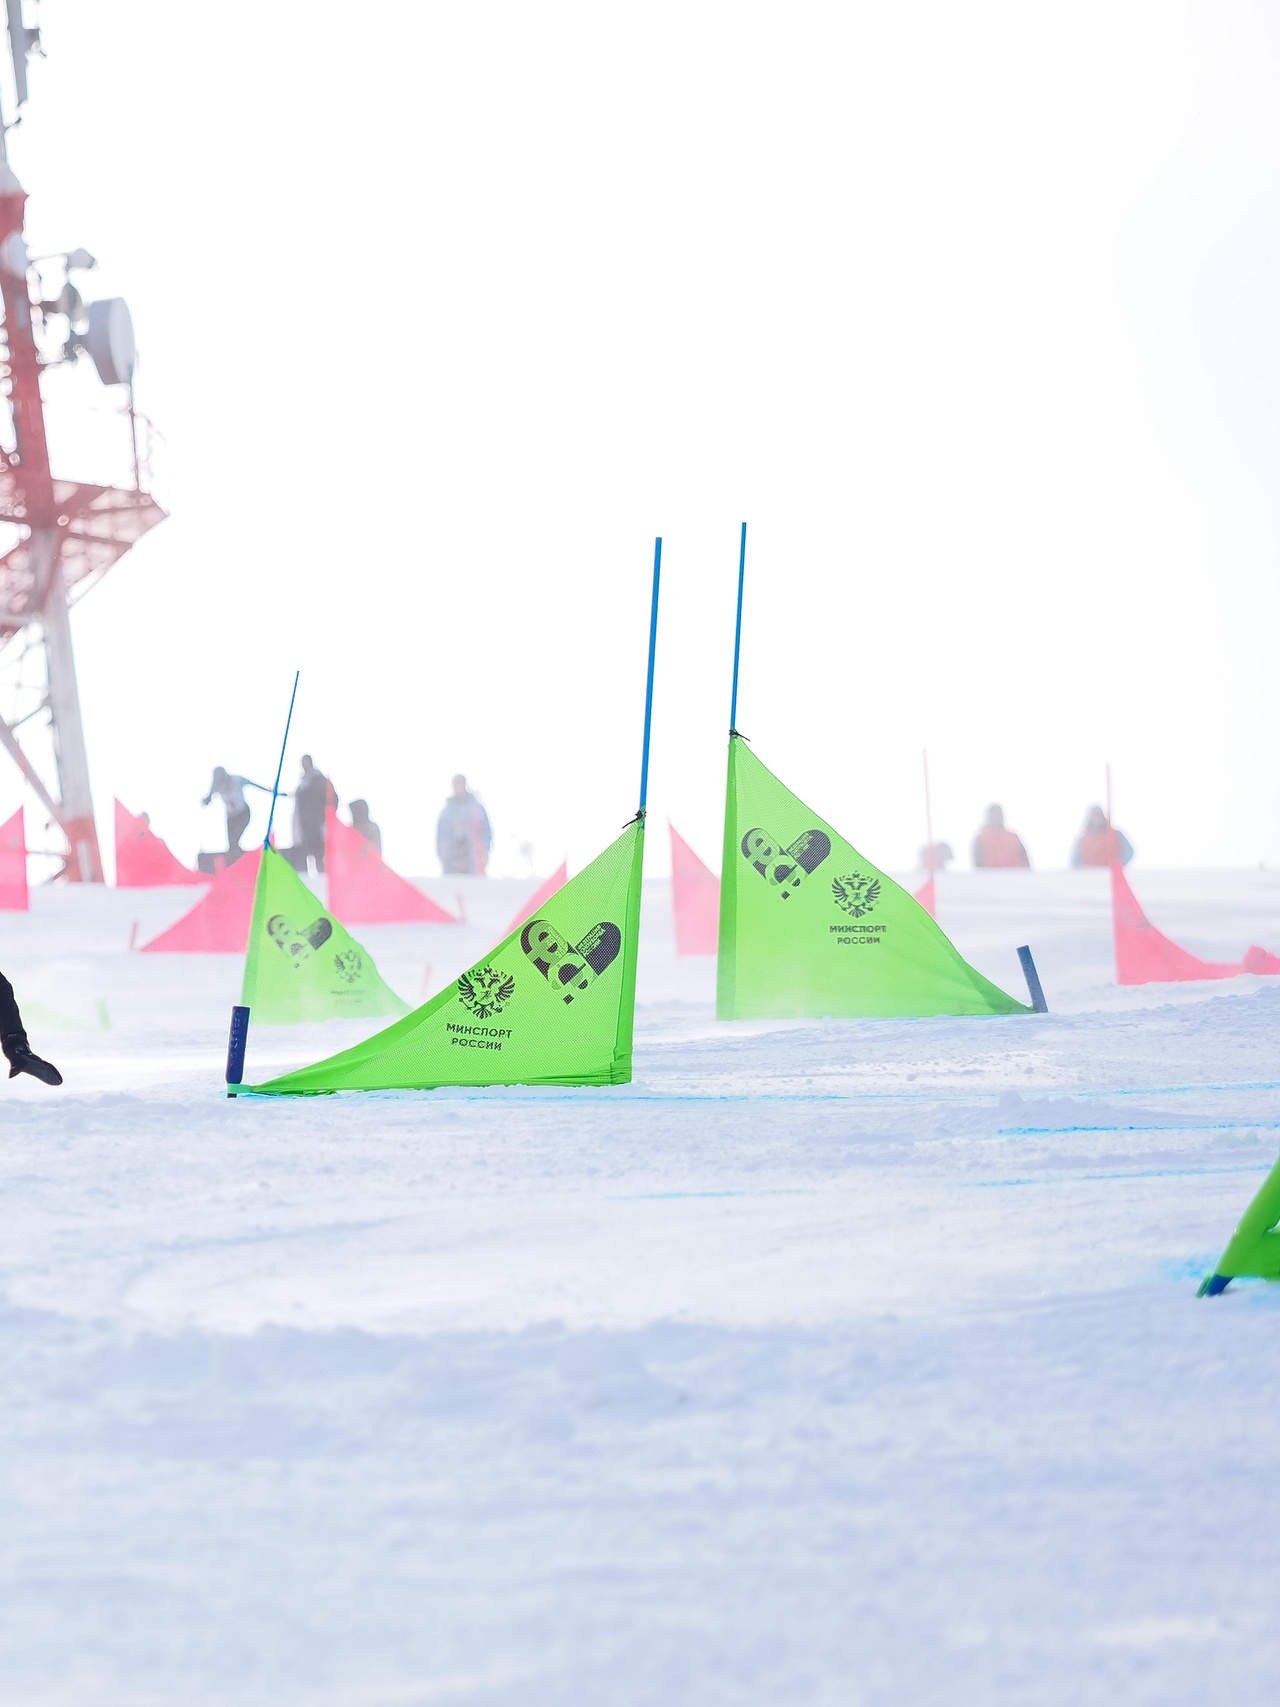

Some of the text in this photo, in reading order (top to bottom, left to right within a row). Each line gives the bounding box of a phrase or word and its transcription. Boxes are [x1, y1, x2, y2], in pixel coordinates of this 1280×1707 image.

[829, 925, 887, 933] МИНСПОРТ
[837, 936, 880, 944] РОССИИ
[446, 1022, 513, 1039] МИНСПОРТ
[451, 1037, 503, 1051] РОССИИ
